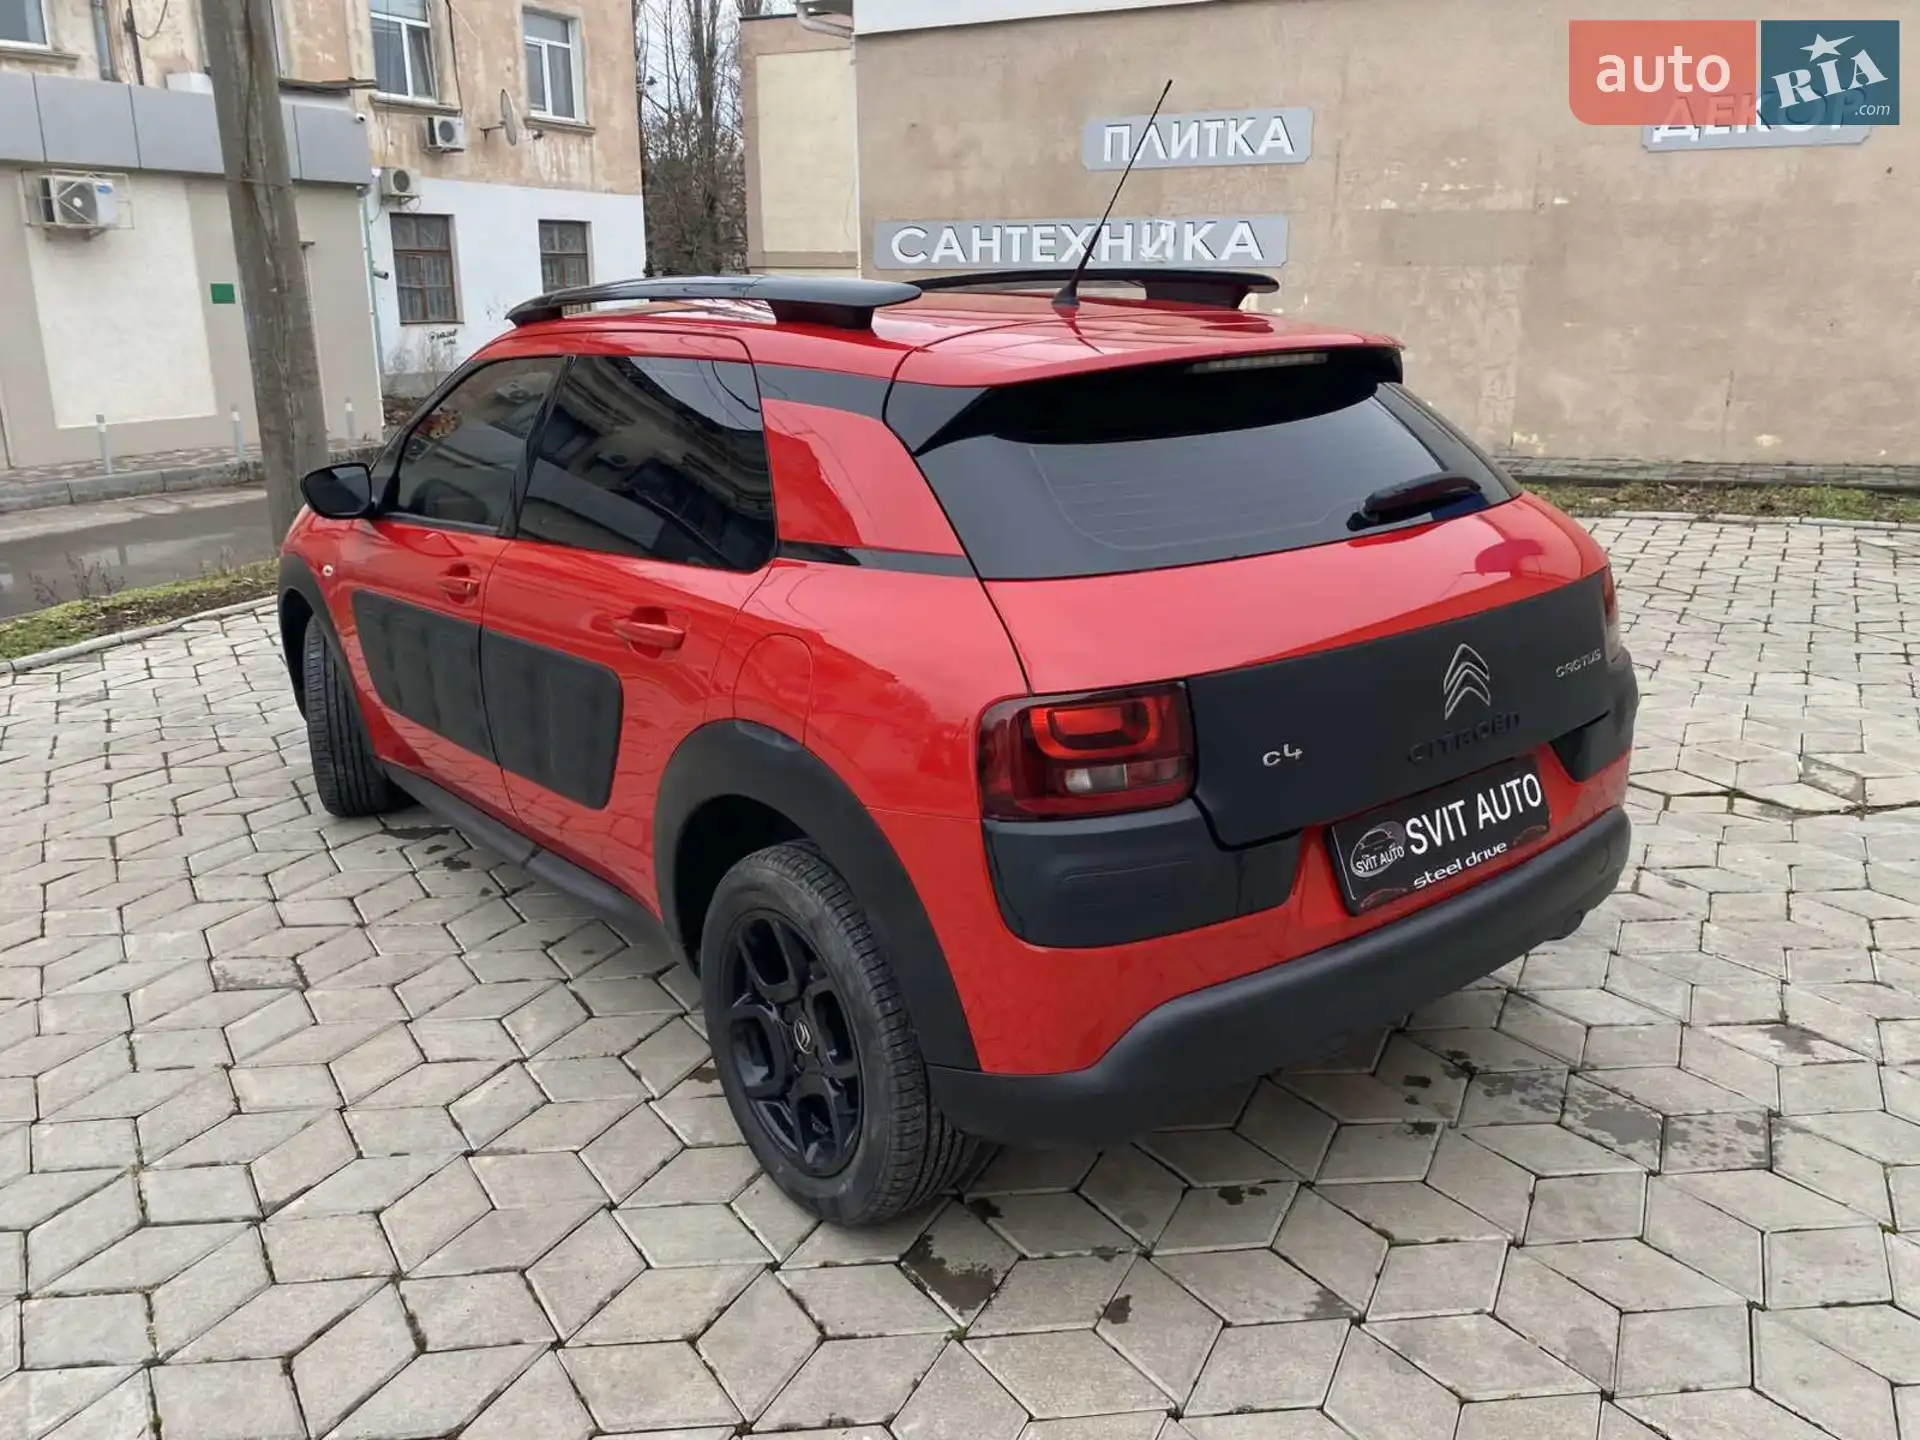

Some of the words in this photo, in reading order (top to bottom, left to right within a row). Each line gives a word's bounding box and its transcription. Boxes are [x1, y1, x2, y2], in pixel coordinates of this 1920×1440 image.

[1103, 115, 1295, 162] ПЛИТКА
[1652, 88, 1867, 144] ДЕКОР
[891, 219, 1265, 264] САНТЕХНИКА
[1262, 742, 1303, 768] C4
[1405, 799, 1468, 856] SVIT
[1476, 773, 1543, 831] AUTO
[1355, 855, 1379, 874] SVIT
[1379, 845, 1405, 866] AUTO
[1413, 858, 1462, 889] steel
[1465, 841, 1508, 867] drive
